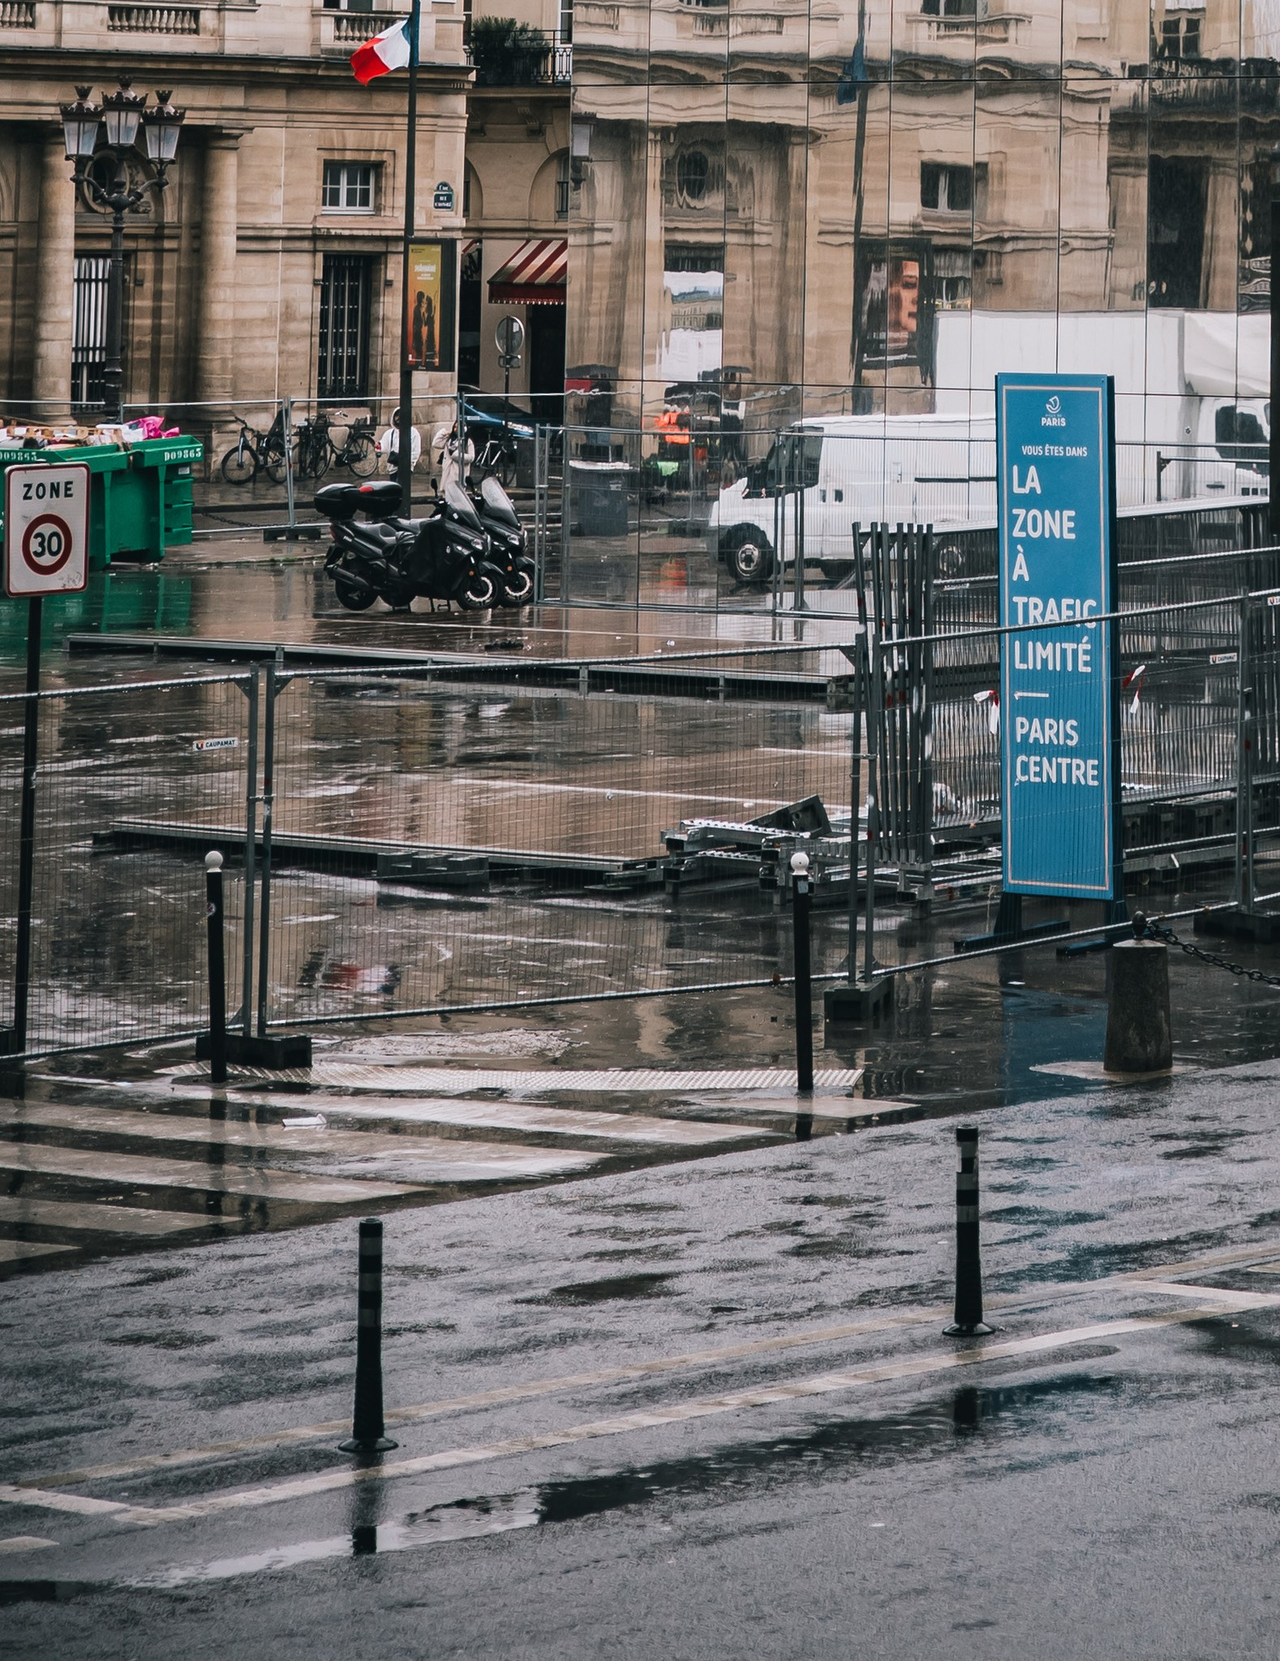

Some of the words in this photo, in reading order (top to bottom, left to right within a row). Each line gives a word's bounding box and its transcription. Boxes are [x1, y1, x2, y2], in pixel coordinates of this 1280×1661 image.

[1041, 417, 1066, 427] PARIS
[1021, 445, 1043, 456] VOUS
[1044, 443, 1064, 456] ÊTES
[1065, 446, 1088, 457] DANS
[22, 480, 74, 500] ZONE
[1012, 464, 1041, 494] LA
[1012, 509, 1076, 539] ZONE
[32, 531, 63, 558] 30
[1012, 544, 1030, 582] À
[1012, 596, 1097, 629] TRAFIC
[1014, 635, 1092, 673] LIMITÉ
[1016, 716, 1079, 746] PARIS
[1016, 755, 1099, 786] CENTRE
